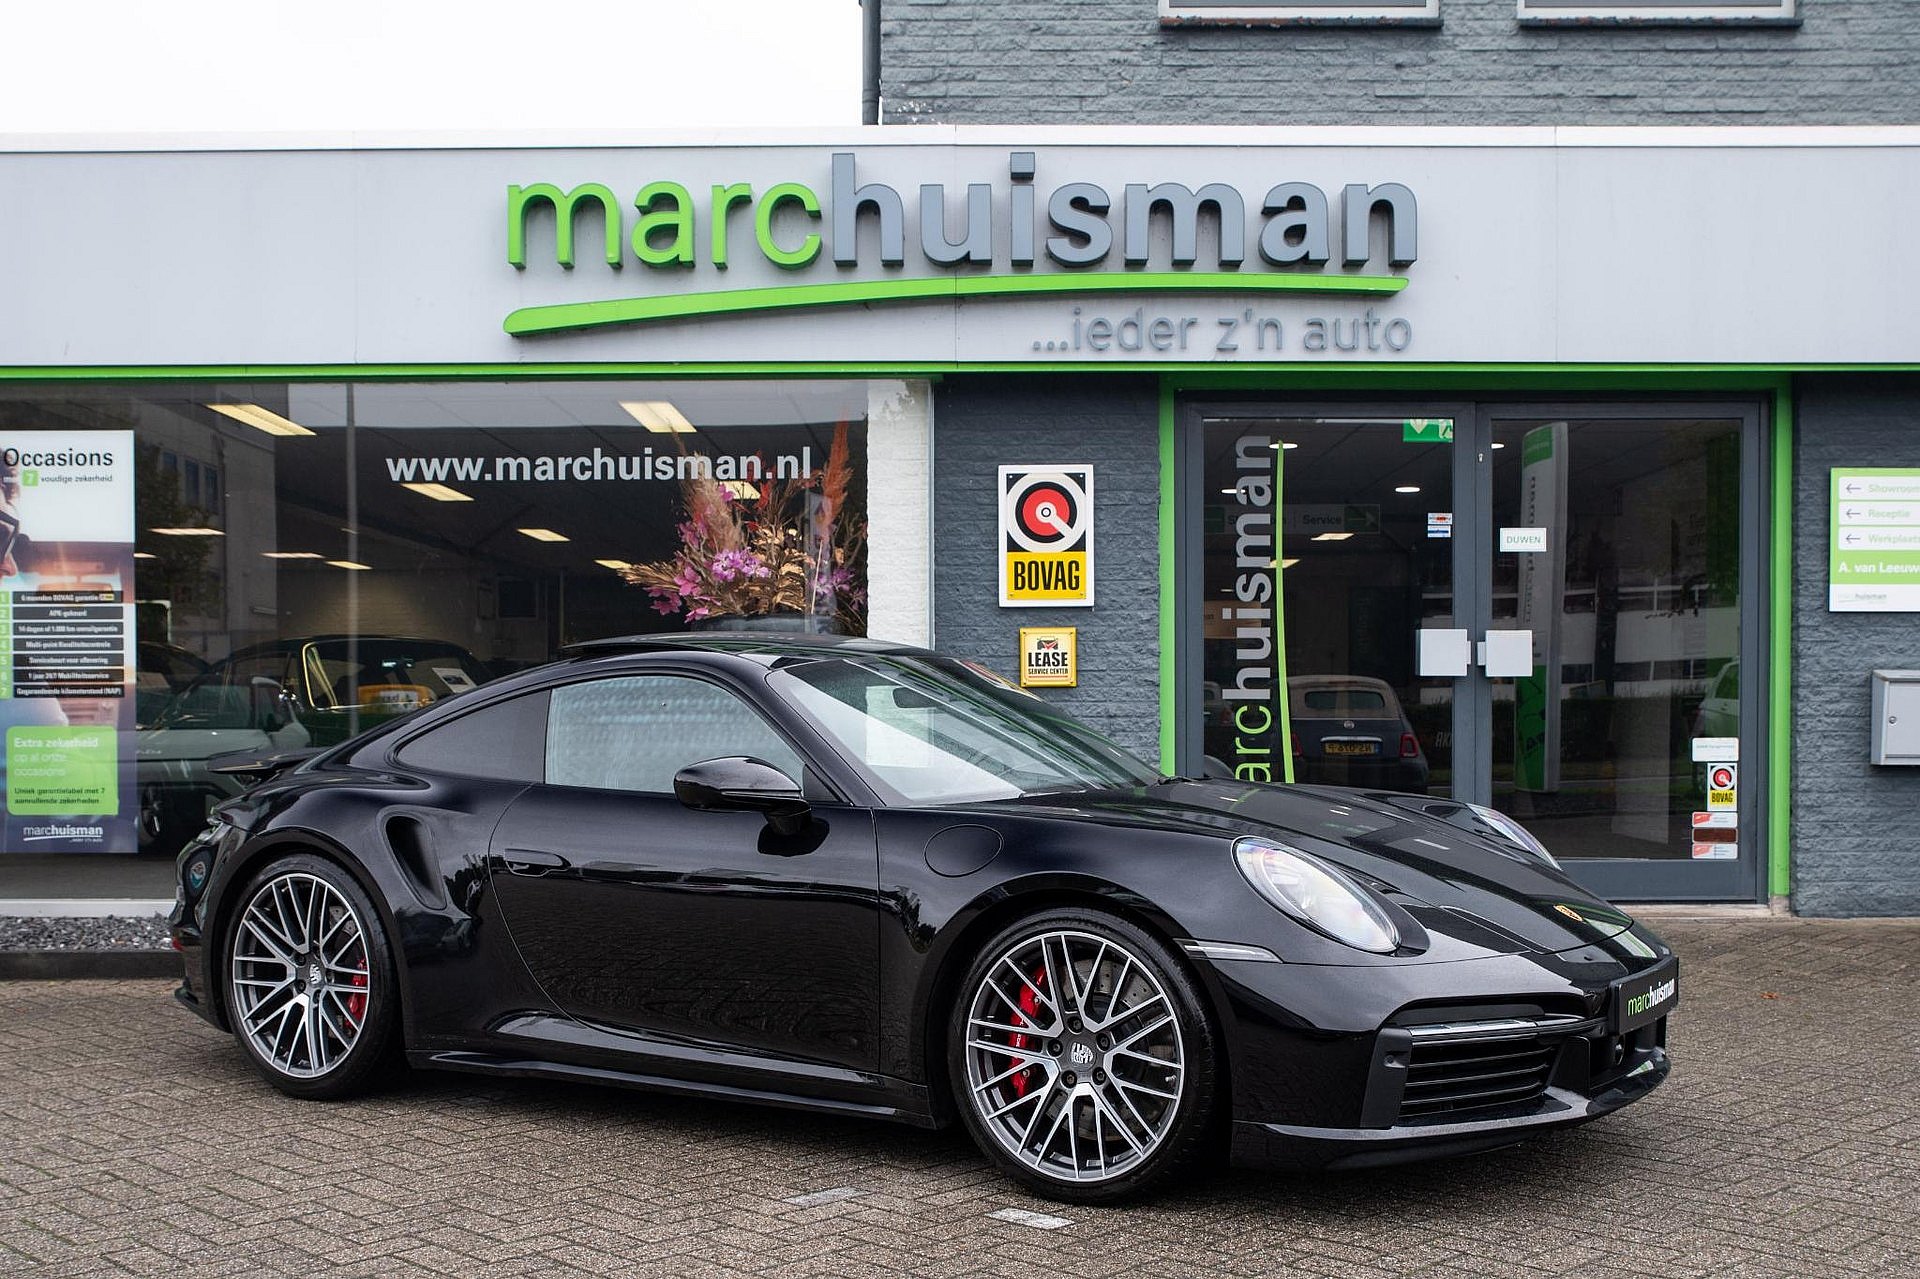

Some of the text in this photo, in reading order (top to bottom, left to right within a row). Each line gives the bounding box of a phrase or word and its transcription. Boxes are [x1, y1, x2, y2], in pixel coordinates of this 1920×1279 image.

[507, 151, 1418, 271] marchuisman
[1215, 306, 1284, 352] z'n
[1303, 307, 1412, 352] auto
[4, 447, 114, 467] Occasions
[386, 446, 811, 482] www.marchuisman.nl
[1506, 536, 1542, 544] DUWEN
[1013, 560, 1080, 591] BOVAG
[1854, 563, 1876, 574] van
[1221, 435, 1272, 783] archuisman
[1028, 652, 1068, 667] LEASE
[1711, 792, 1734, 803] BOVAG
[23, 824, 104, 836] marchuisman
[1627, 978, 1675, 1017] marchuisman
